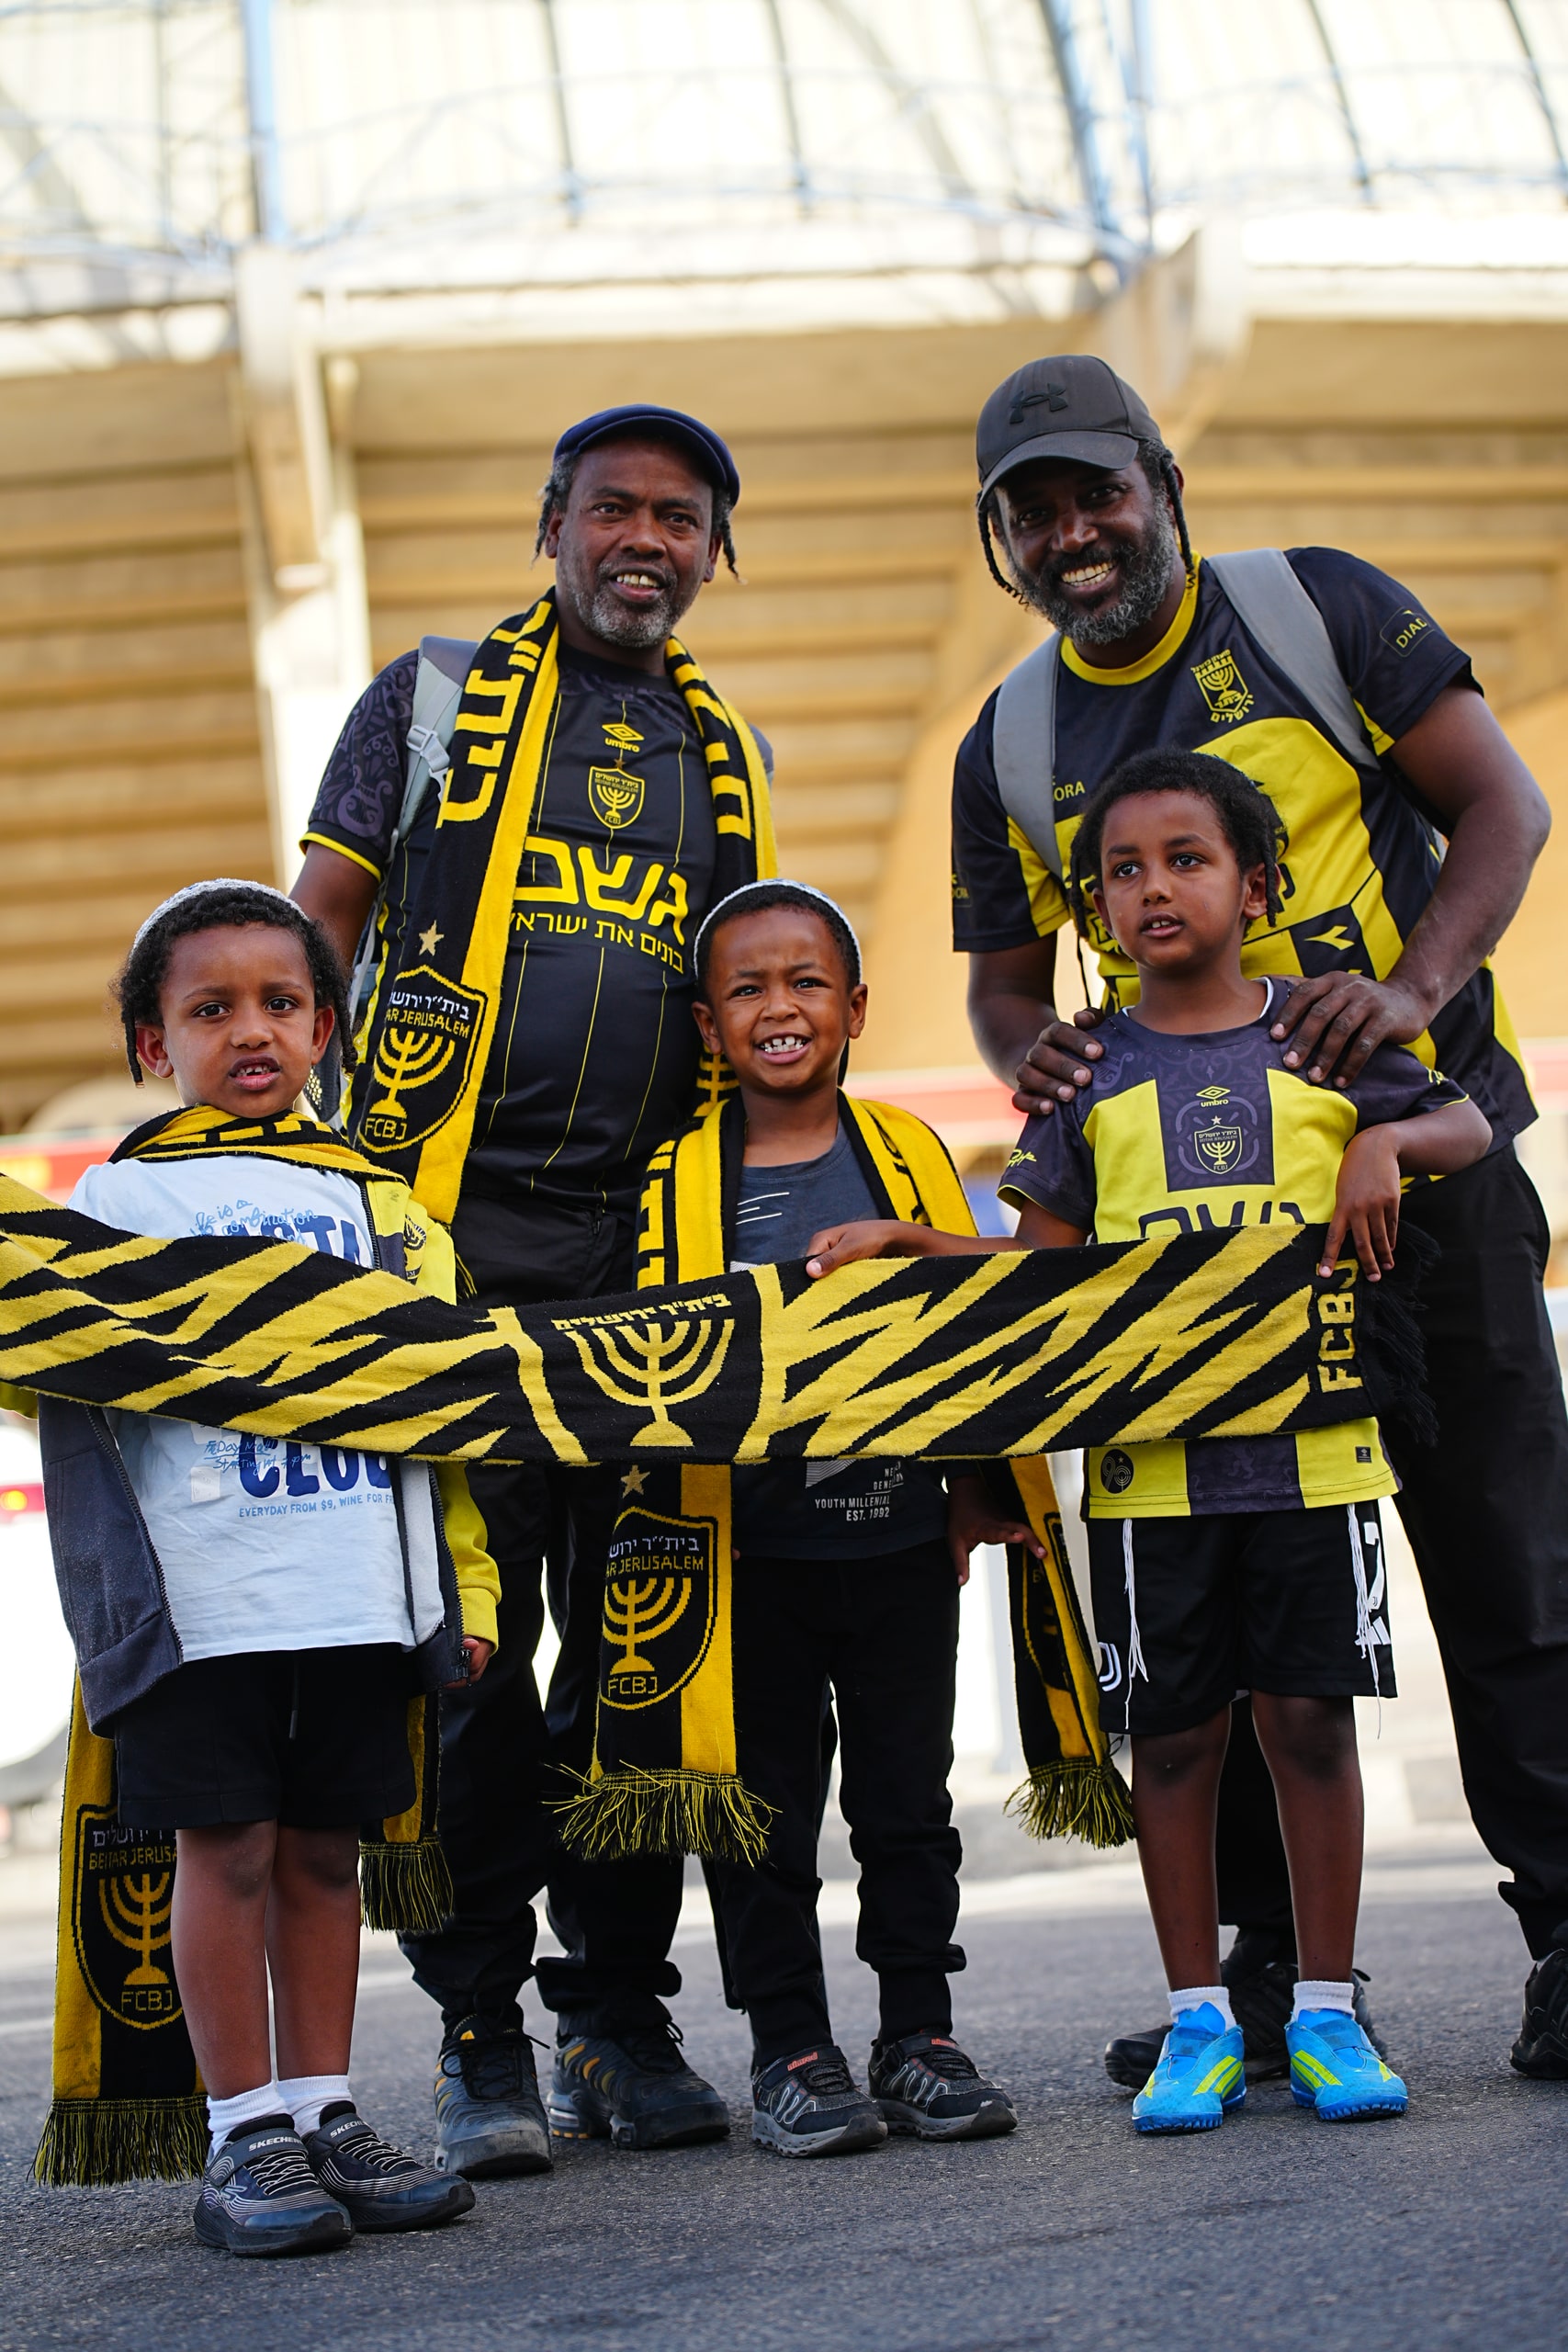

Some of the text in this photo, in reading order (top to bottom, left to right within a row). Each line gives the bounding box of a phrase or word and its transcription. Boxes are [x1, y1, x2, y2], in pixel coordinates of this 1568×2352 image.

[604, 738, 640, 752] umbro
[594, 920, 634, 947] את
[640, 933, 684, 974] בונים
[391, 991, 423, 1008] ירוש
[399, 1010, 470, 1039] JERUSALEM
[1201, 1099, 1229, 1107] umbro
[365, 1117, 407, 1140] FCBJ
[551, 1306, 658, 1330] ירושלים
[1315, 1259, 1363, 1393] FCBJ
[239, 1505, 288, 1518] EVERYDAY
[290, 1502, 317, 1514] FROM
[321, 1499, 336, 1510] $9,
[339, 1494, 363, 1507] WINE
[367, 1493, 382, 1503] FOR
[815, 1495, 890, 1509] YOUTH MILLENIAL
[846, 1507, 889, 1521] EST. 1992
[609, 1540, 637, 1558] ירוש
[618, 1555, 704, 1575] JERUSALEM
[608, 1677, 658, 1698] FCBJ
[89, 1846, 177, 1871] BEITAR JERUSA
[121, 1990, 173, 2012] FCBJ
